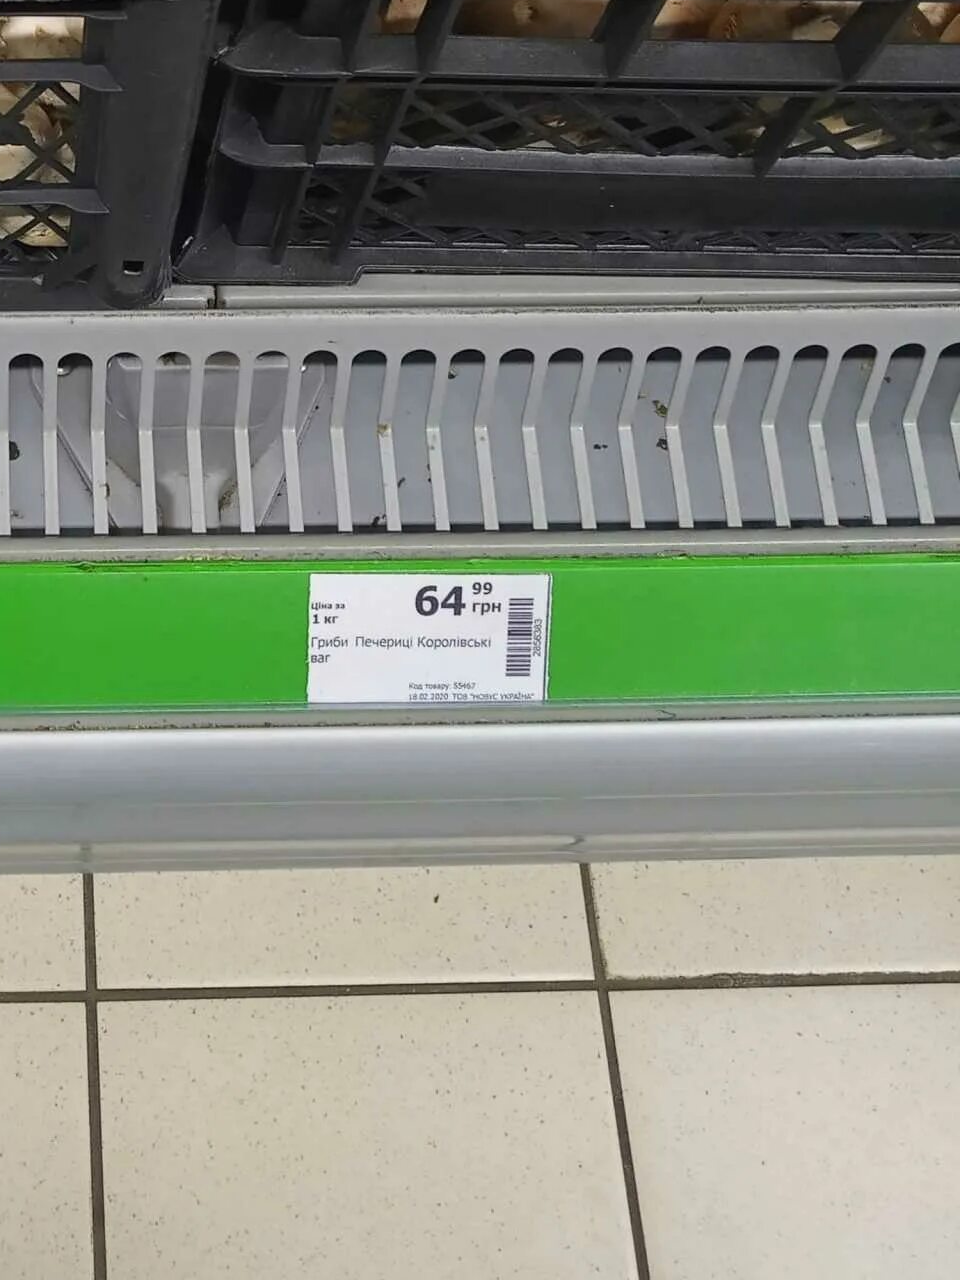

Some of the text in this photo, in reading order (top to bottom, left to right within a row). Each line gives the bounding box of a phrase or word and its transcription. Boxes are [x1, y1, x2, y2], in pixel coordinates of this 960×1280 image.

[471, 582, 493, 595] 99
[311, 602, 333, 611] Ціна
[415, 585, 466, 616] 64
[472, 600, 502, 615] грн
[312, 614, 339, 624] 1 кг
[311, 635, 492, 650] Гриби Печериці Королівські
[310, 654, 331, 664] ваг
